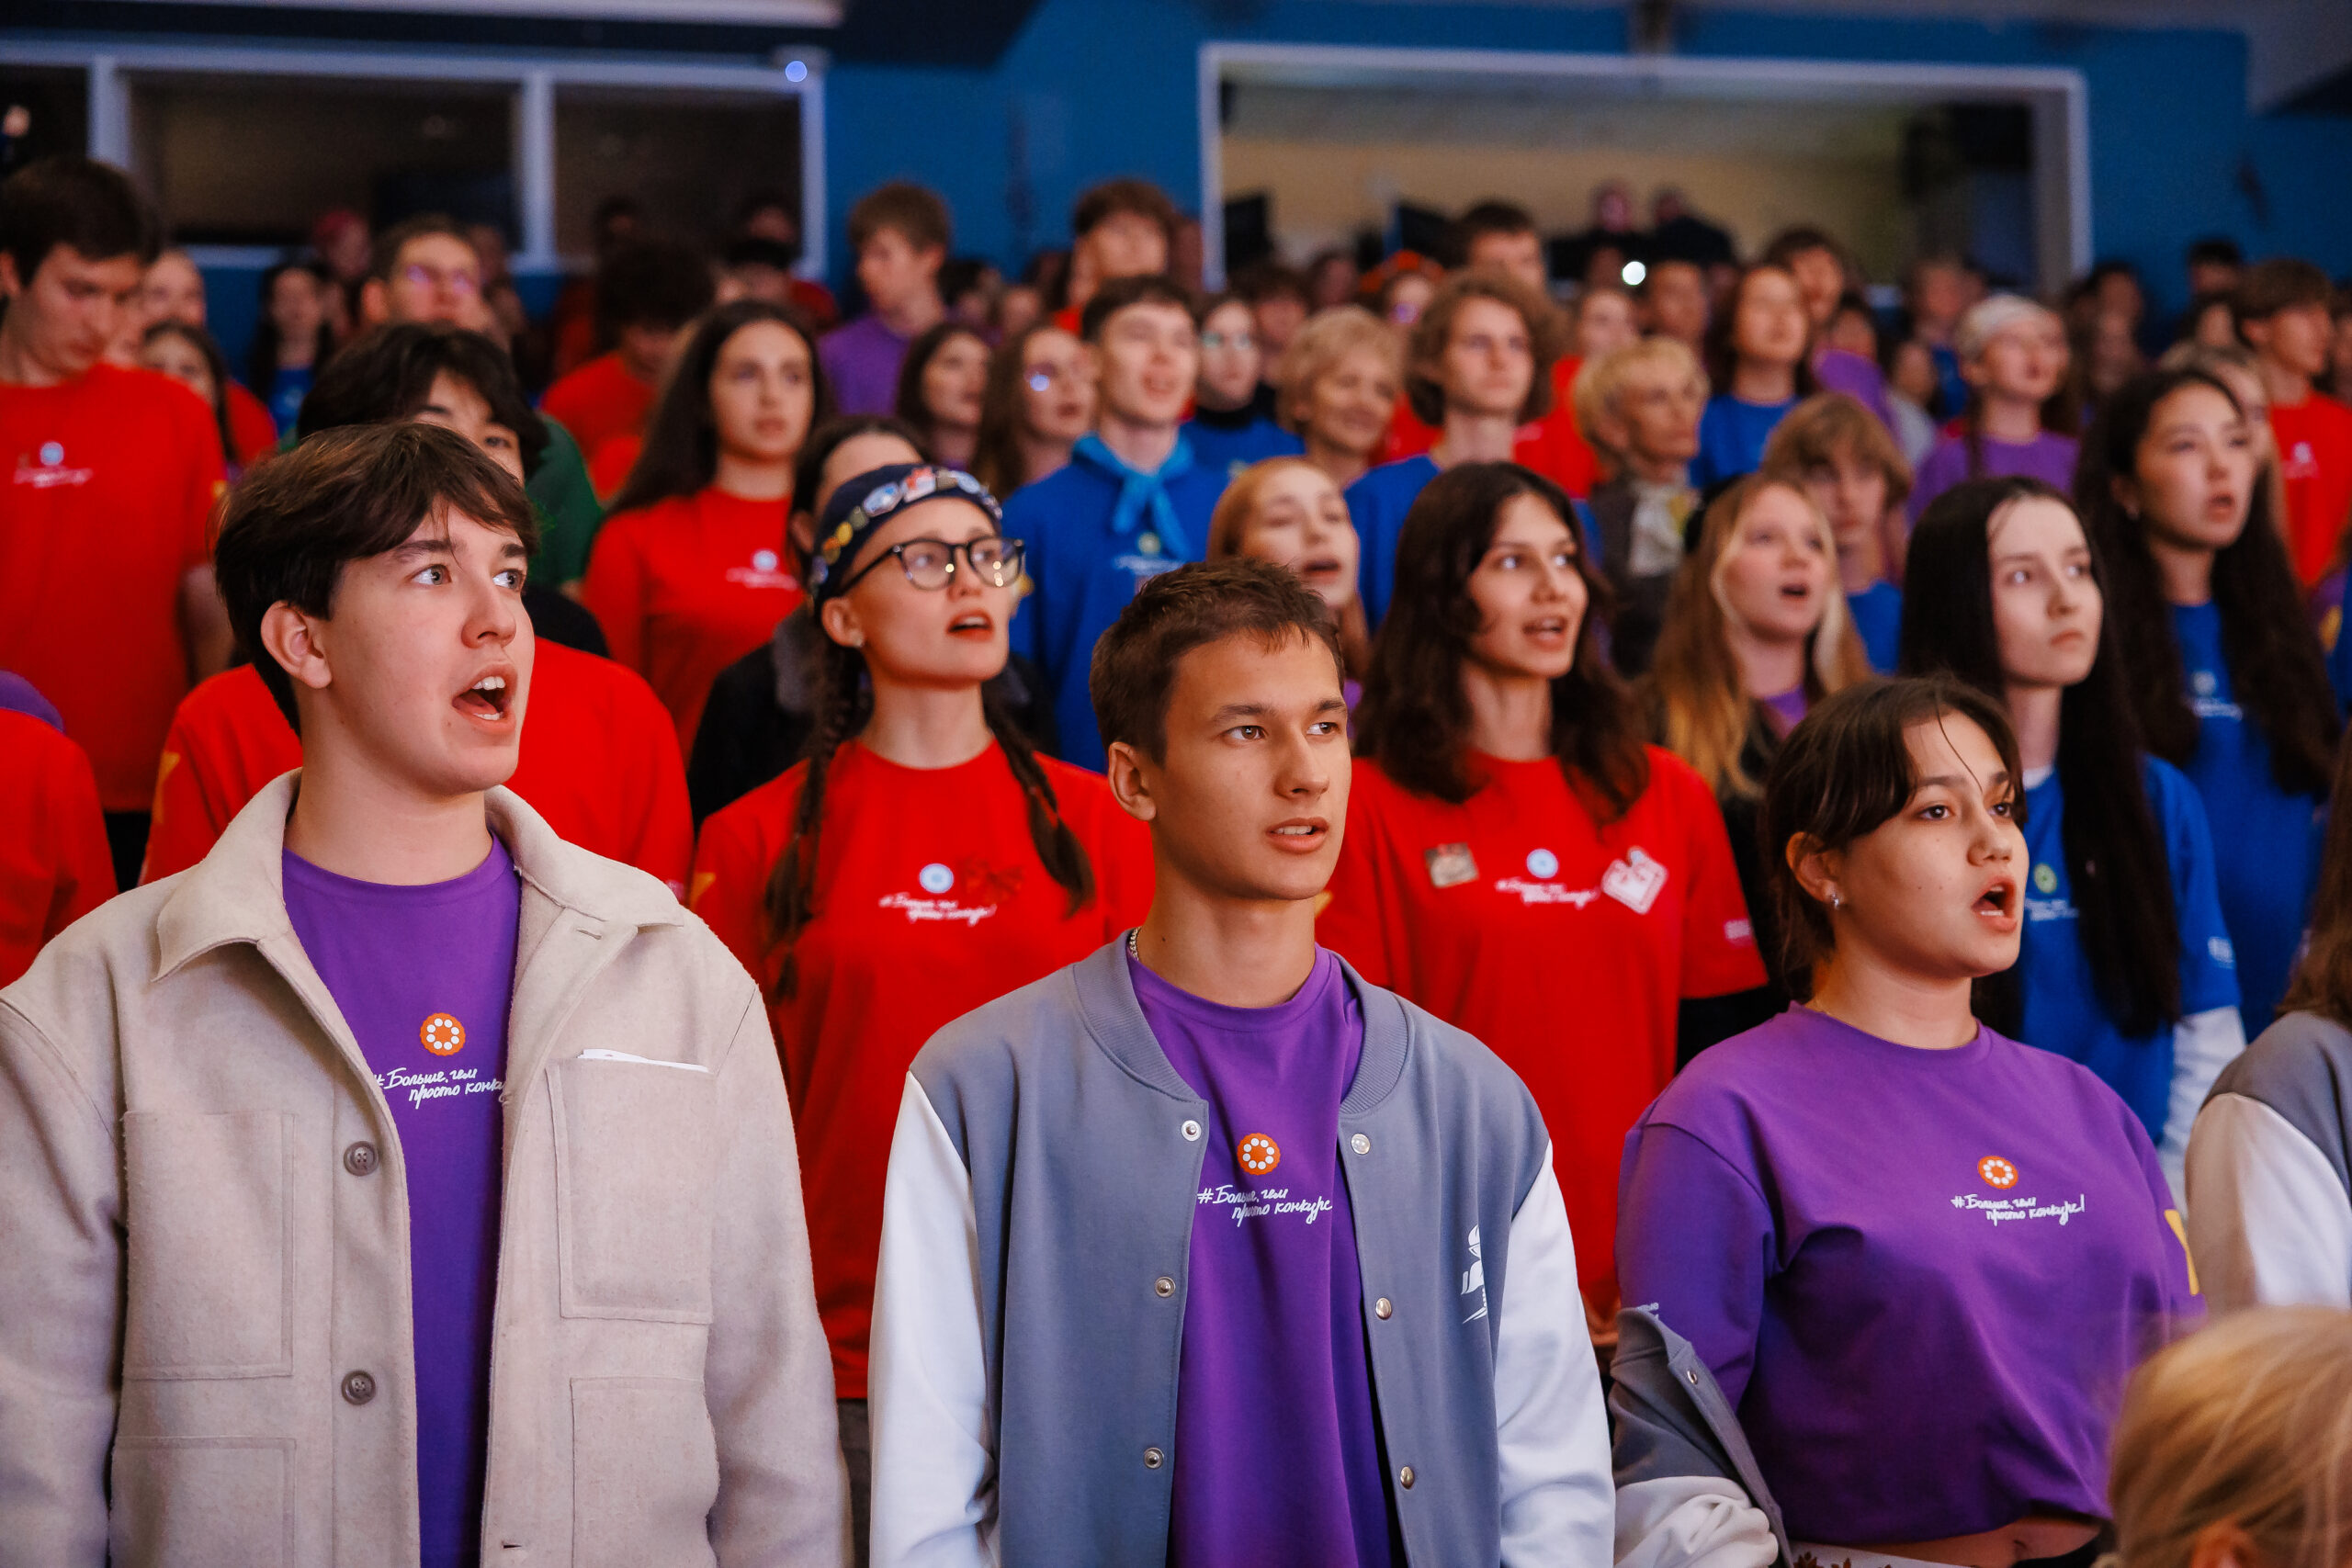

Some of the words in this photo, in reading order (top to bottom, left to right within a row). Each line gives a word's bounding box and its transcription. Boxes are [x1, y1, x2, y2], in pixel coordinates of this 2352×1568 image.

[449, 1068, 478, 1081] чем
[408, 1084, 461, 1110] просто
[464, 1077, 505, 1103] конк
[1261, 1188, 1289, 1200] чем
[1274, 1195, 1333, 1224] конкурс
[1985, 1209, 2026, 1226] просто
[2029, 1193, 2086, 1225] конкурс!
